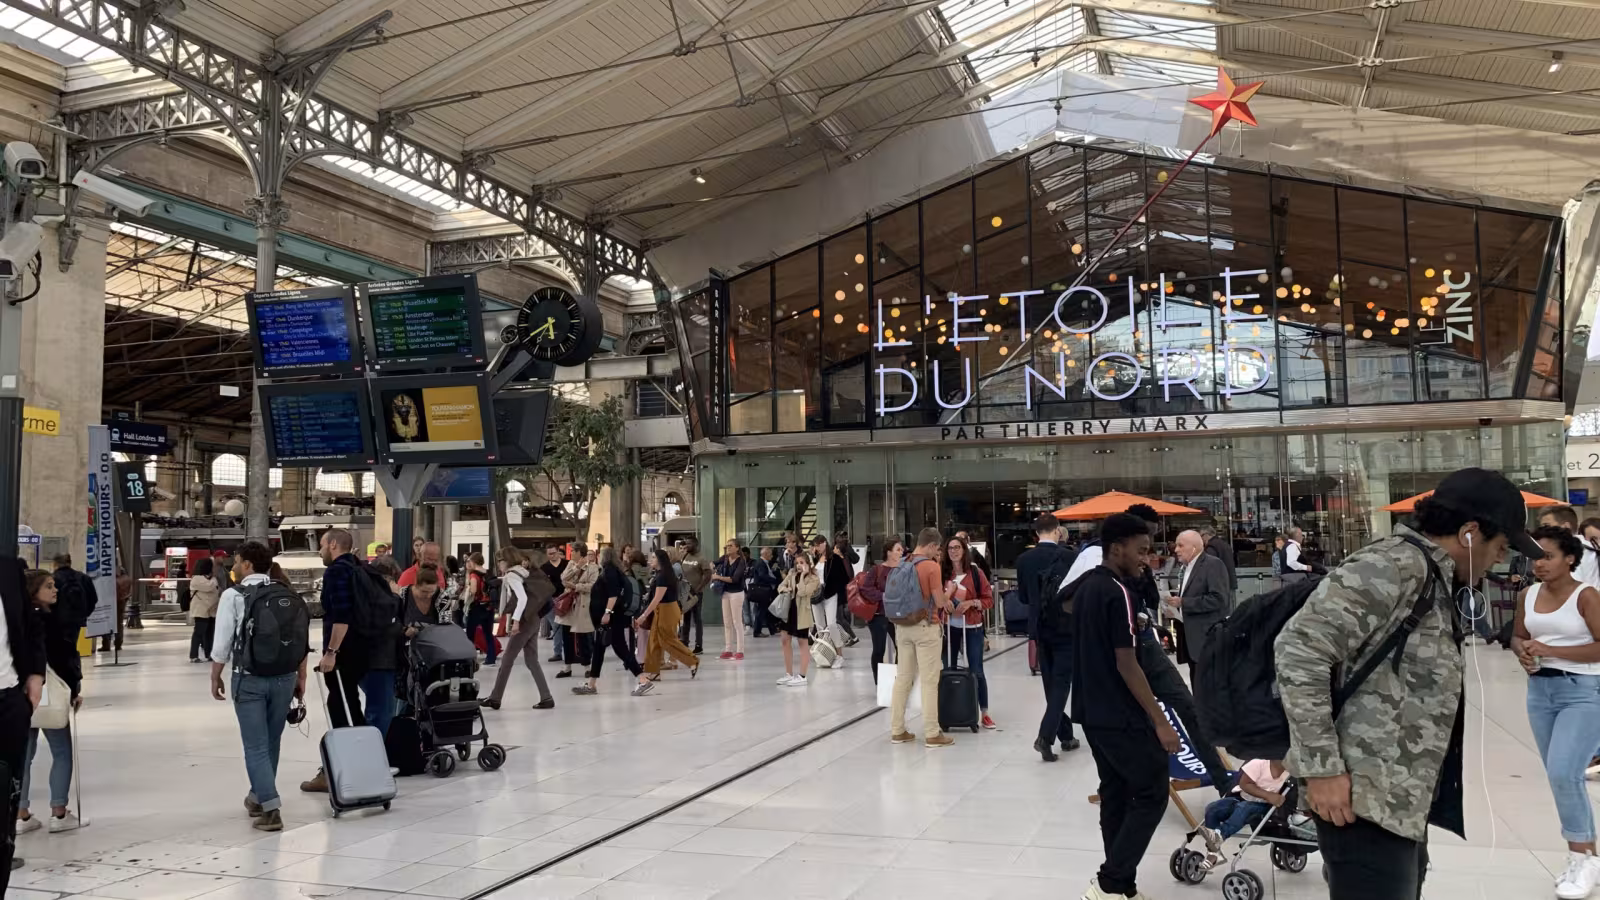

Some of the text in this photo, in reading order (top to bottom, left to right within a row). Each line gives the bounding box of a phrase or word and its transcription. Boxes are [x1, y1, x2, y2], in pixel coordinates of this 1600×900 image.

[873, 266, 1269, 351] L'ETOILE
[1443, 271, 1474, 343] ZINC
[1420, 318, 1447, 345] LE
[874, 340, 1272, 416] DU NORD
[123, 432, 157, 442] Hall Londres
[941, 415, 1209, 440] PAR THIERRY MARX
[1567, 460, 1582, 471] et
[127, 480, 144, 496] 18
[100, 483, 111, 531] HOURS
[101, 533, 112, 577] HAPPY
